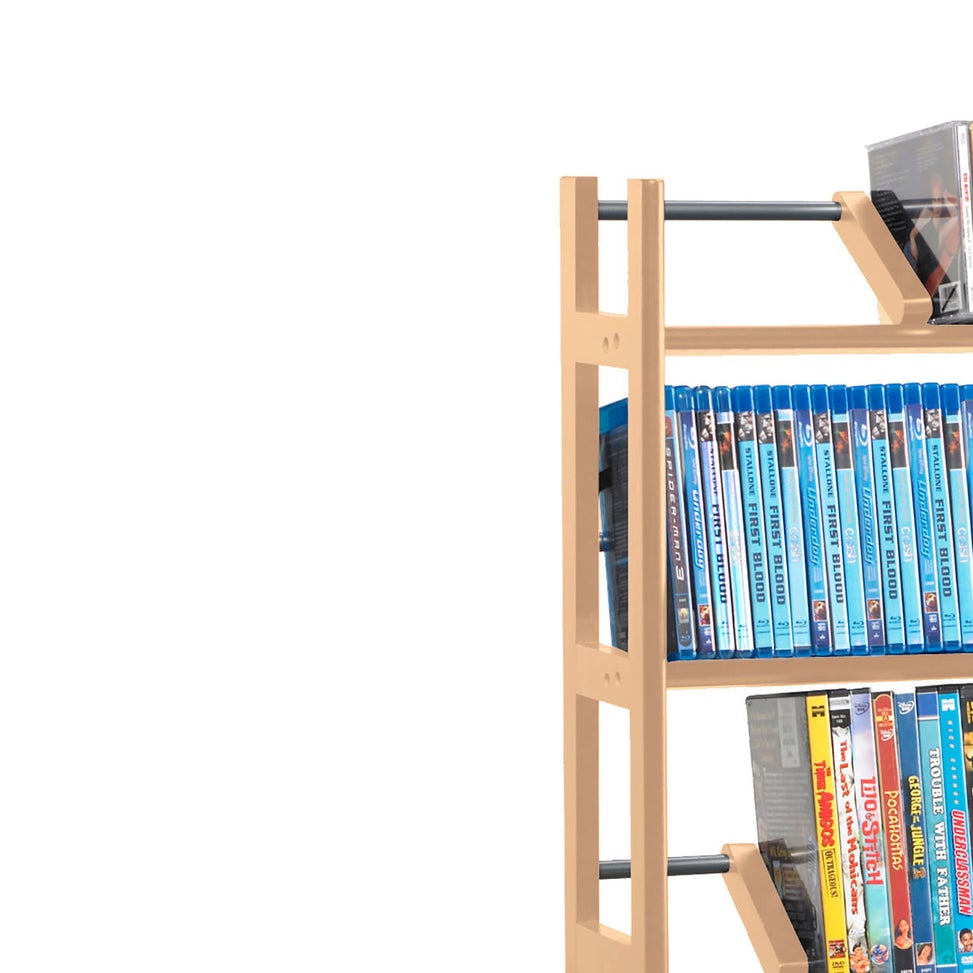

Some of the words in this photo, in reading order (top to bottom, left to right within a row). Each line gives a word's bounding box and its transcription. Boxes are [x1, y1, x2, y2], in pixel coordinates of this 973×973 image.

[745, 447, 756, 497] STALLONE
[767, 450, 778, 498] STALLONE
[823, 449, 834, 498] STALLONE
[879, 446, 890, 494] STALLONE
[748, 502, 761, 545] FIRST
[769, 505, 782, 549] FIRST
[806, 487, 821, 566] Underdog
[827, 504, 839, 548] FIRST
[862, 486, 875, 565] Underdog
[882, 500, 894, 544] FIRST
[917, 480, 932, 559] Underdog
[752, 552, 765, 603] BLOOD
[773, 554, 786, 605] BLOOD
[832, 554, 844, 604] BLOOD
[886, 549, 898, 600] BLOOD
[838, 740, 848, 763] The
[839, 763, 852, 798] Last
[929, 748, 944, 814] TROUBLE
[844, 801, 853, 814] of
[845, 816, 856, 835] the
[884, 790, 904, 871] POCAHONTAS
[934, 822, 947, 860] WITH
[951, 809, 972, 916] UNDERCLASSMAN
[847, 838, 861, 915] Mohicans
[936, 868, 951, 925] FATHER
